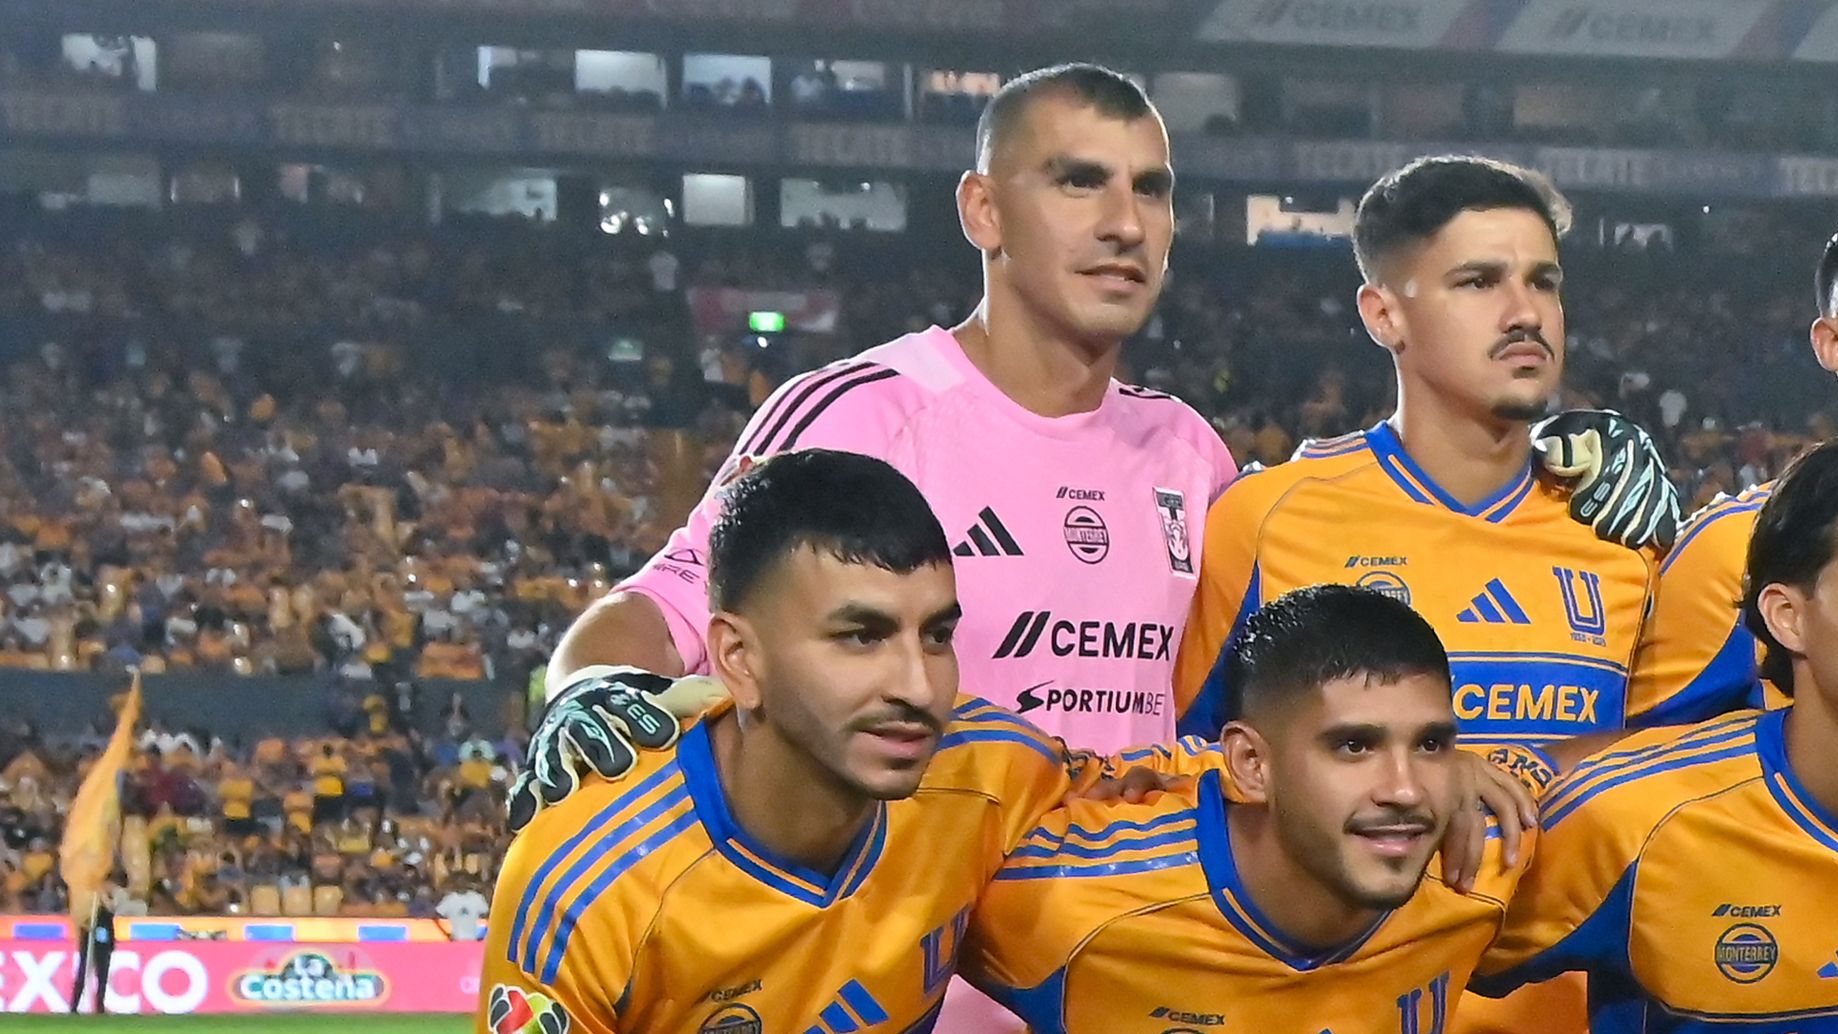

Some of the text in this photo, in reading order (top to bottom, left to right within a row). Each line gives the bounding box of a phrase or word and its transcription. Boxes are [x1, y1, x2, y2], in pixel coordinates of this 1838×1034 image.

[1068, 489, 1106, 501] CEMEX
[1360, 556, 1408, 567] CEMEX
[1552, 566, 1606, 636] U
[1050, 620, 1175, 662] CEMEX
[1453, 684, 1600, 724] CEMEX
[1730, 904, 1781, 917] CEMEX
[1717, 945, 1776, 963] MONTERREY
[1169, 1011, 1225, 1026] CEMEX
